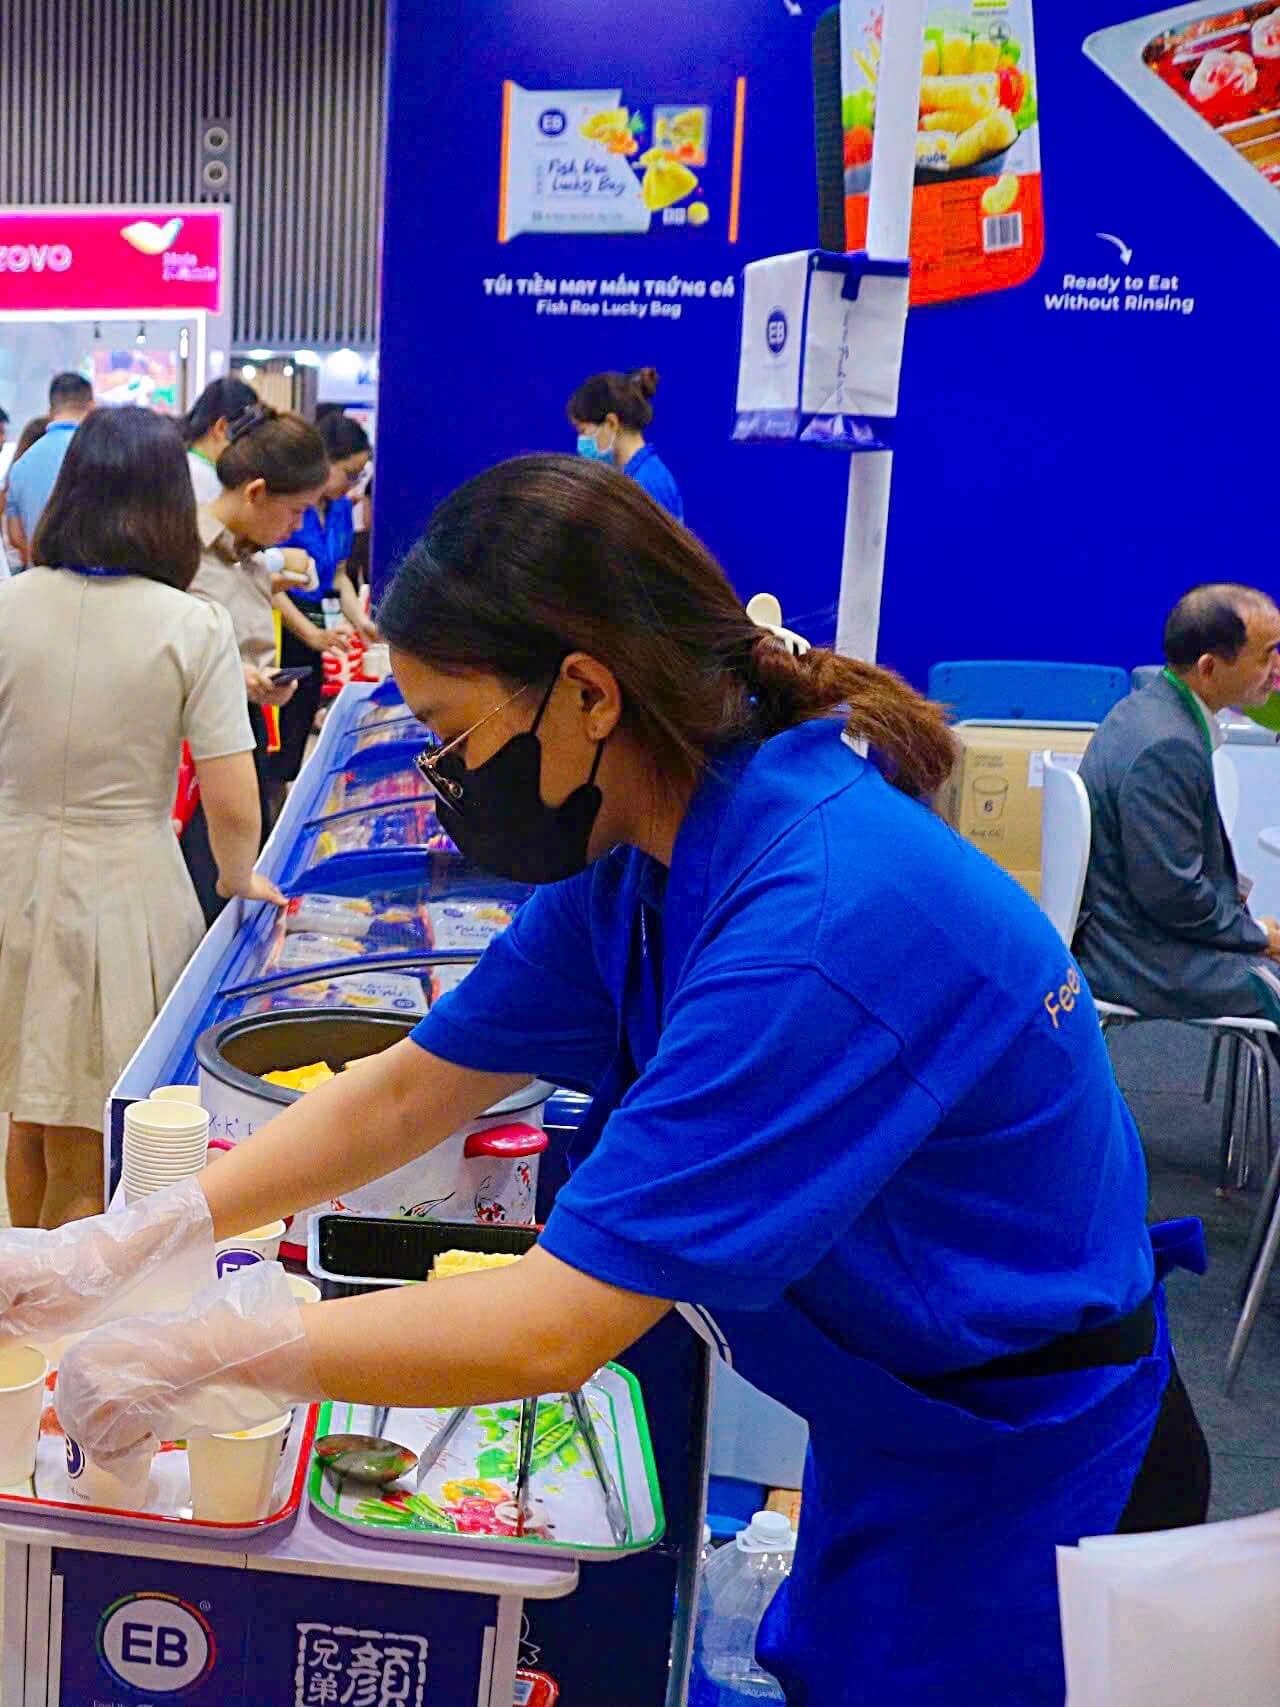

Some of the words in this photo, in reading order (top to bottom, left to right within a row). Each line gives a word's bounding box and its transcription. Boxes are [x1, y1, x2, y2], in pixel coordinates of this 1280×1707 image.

[560, 278, 598, 297] MAY
[1063, 274, 1120, 294] Ready
[1124, 275, 1144, 291] to
[1148, 274, 1179, 291] Eat
[536, 300, 568, 316] Fish
[571, 300, 600, 316] Roe
[602, 300, 648, 319] Lucky
[650, 301, 682, 320] Bag
[1044, 293, 1120, 311] Without
[1124, 293, 1195, 315] Rinsing
[121, 1621, 188, 1668] EB
